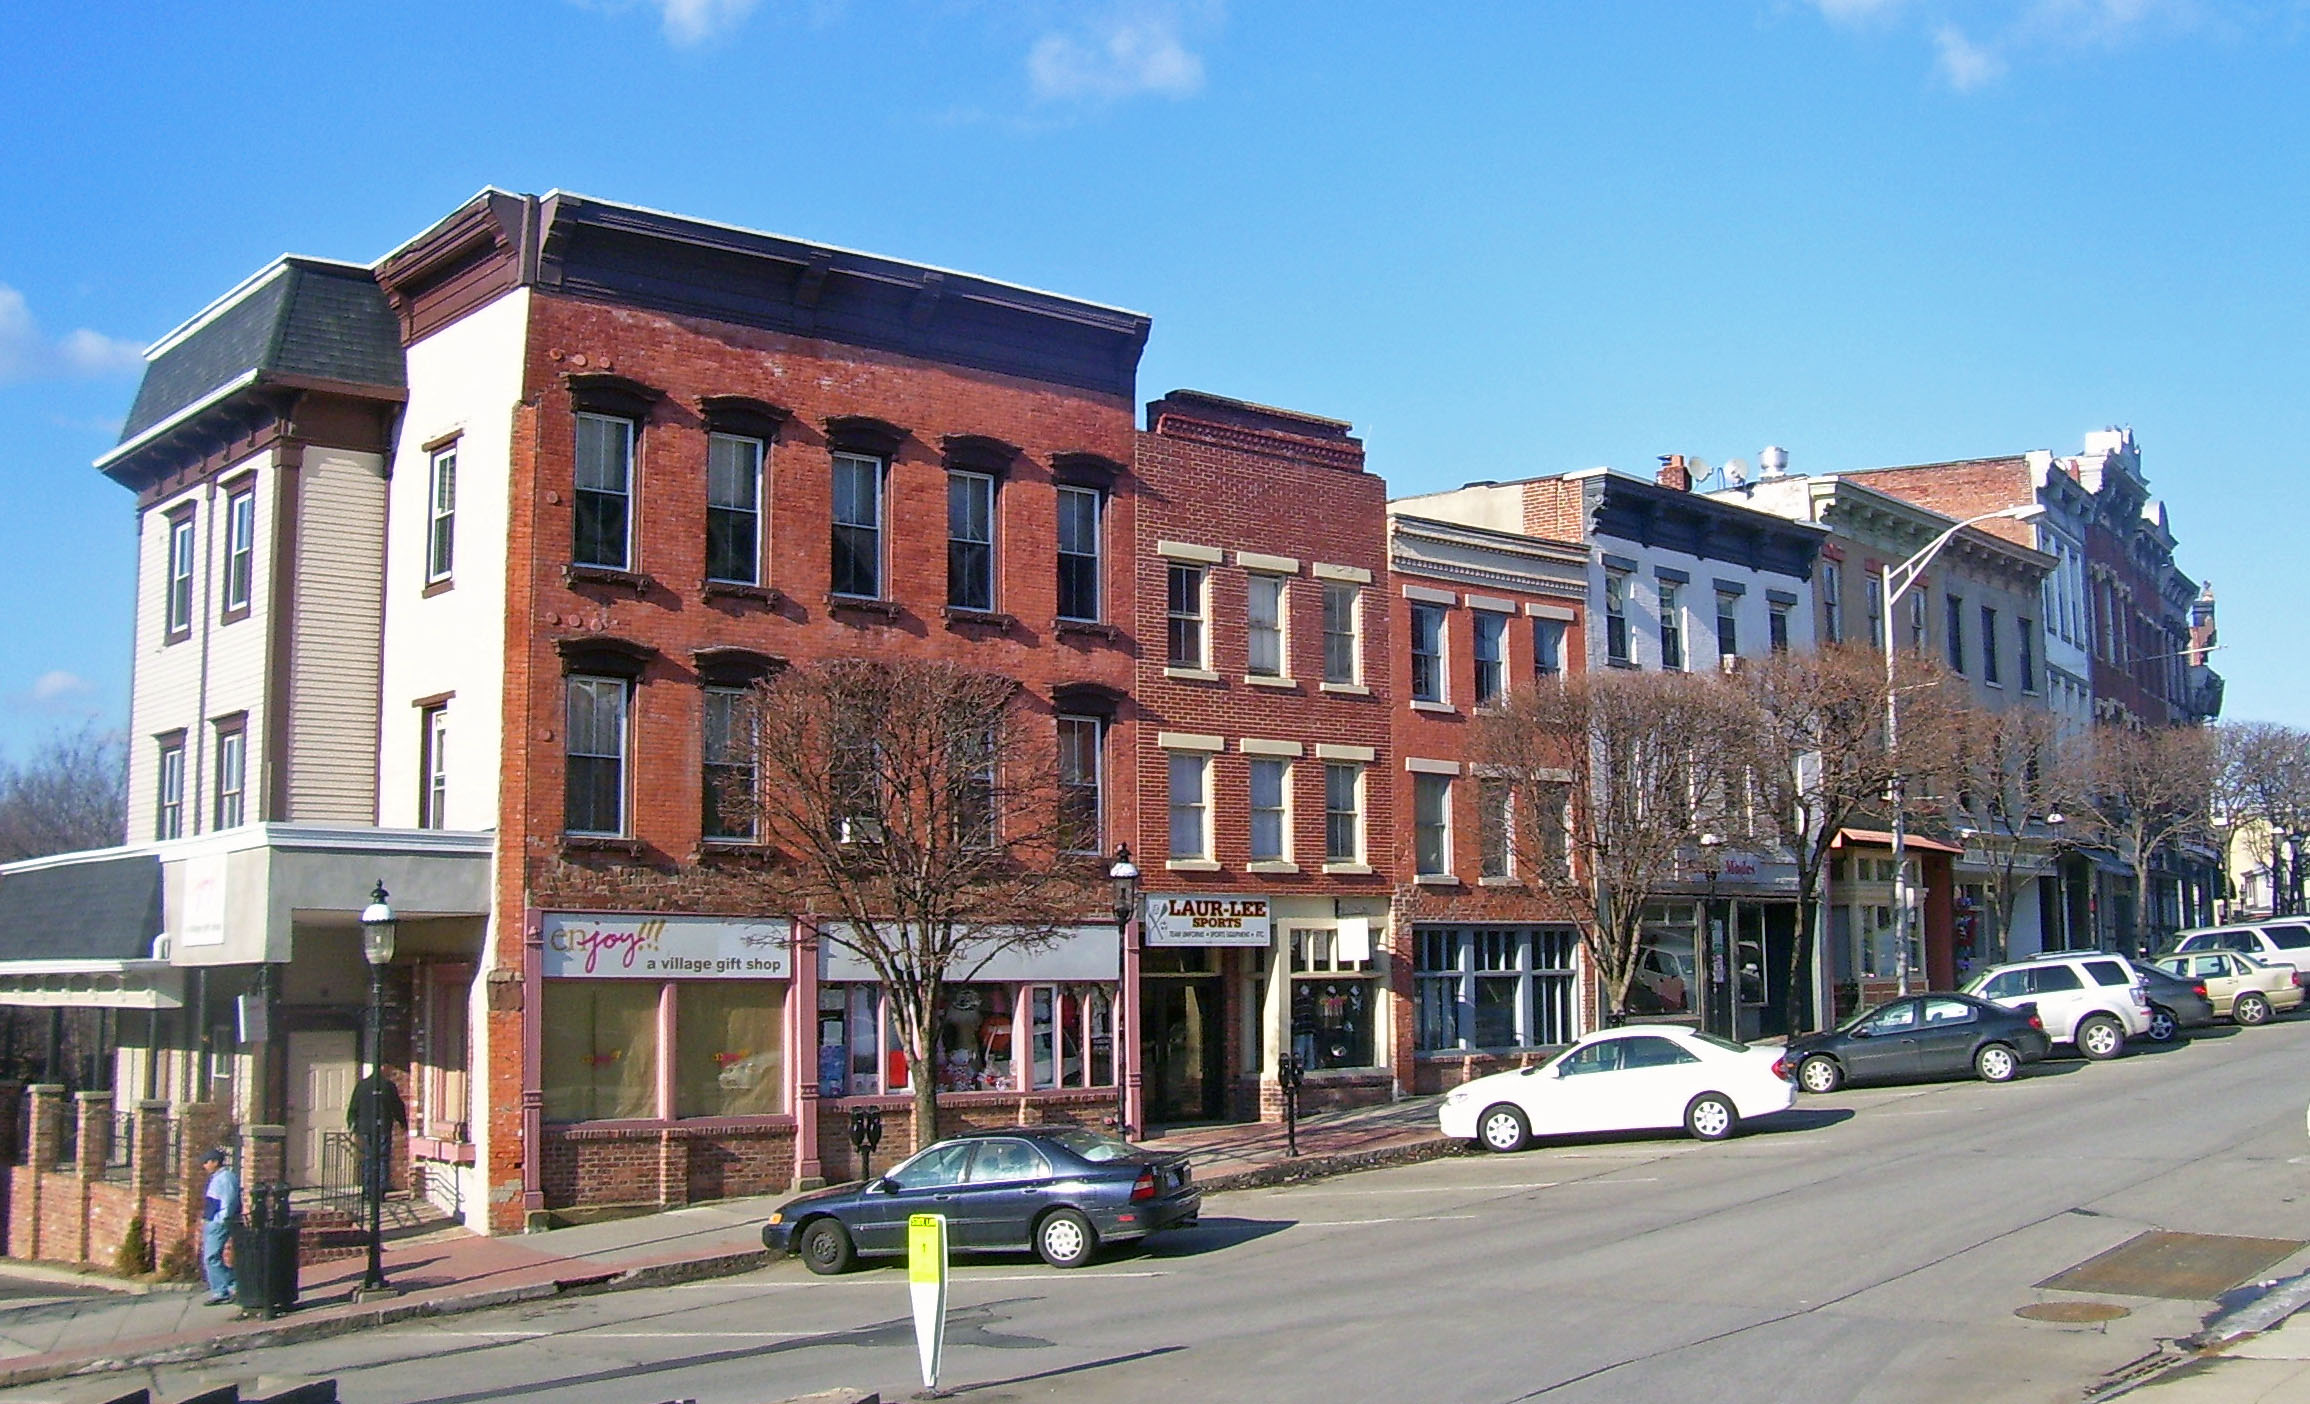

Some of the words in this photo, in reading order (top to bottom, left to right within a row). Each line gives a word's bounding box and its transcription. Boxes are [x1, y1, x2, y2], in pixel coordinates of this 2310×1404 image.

[1168, 899, 1267, 917] LAUR-LEE
[1192, 917, 1242, 928] SPORTS
[551, 919, 667, 974] enjoy!!!
[646, 959, 656, 970] a
[661, 957, 712, 973] village
[716, 957, 742, 973] gift
[746, 958, 781, 973] shop
